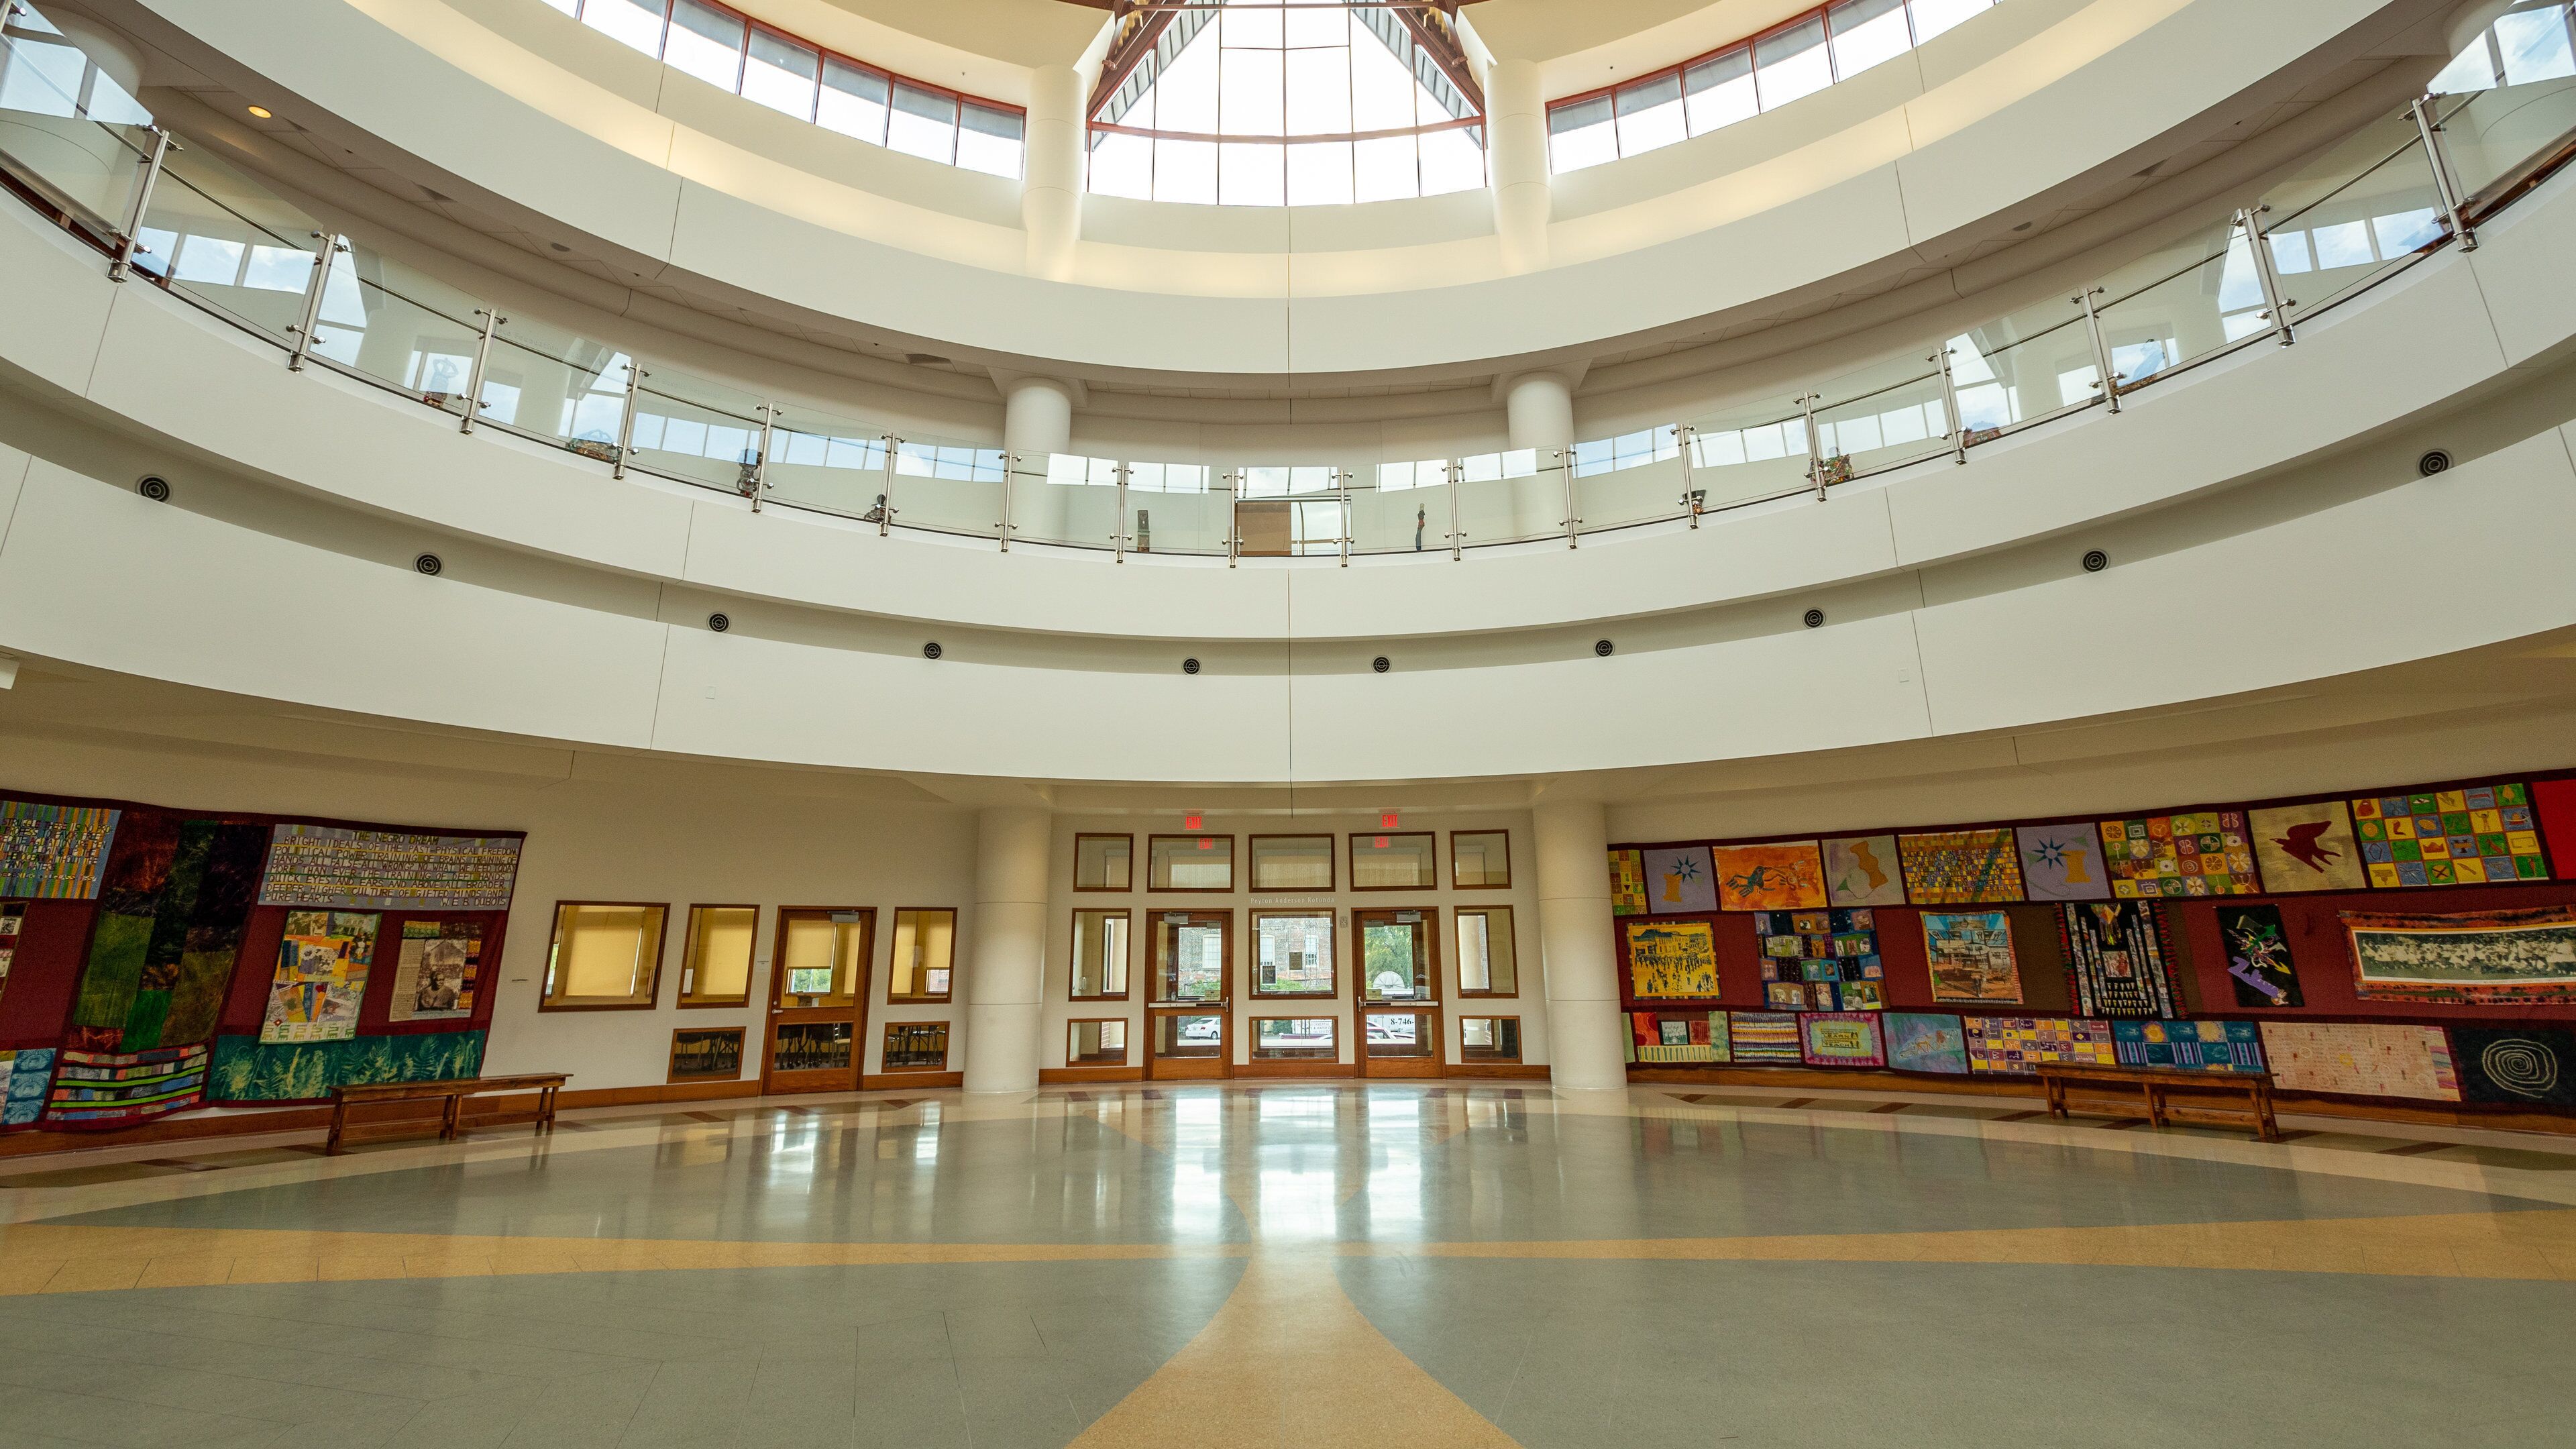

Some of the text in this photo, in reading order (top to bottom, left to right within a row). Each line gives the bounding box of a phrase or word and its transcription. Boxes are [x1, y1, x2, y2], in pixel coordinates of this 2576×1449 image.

[1186, 816, 1202, 829] EXIT
[1382, 814, 1397, 827] EXIT
[352, 831, 439, 845] THE NEGRO DREAM
[328, 839, 362, 850] IDEALS
[386, 843, 402, 852] THE
[274, 846, 331, 857] POLITICAL
[373, 852, 418, 862] TRAINING
[439, 856, 466, 864] BRAINS
[272, 855, 304, 865] HANDS
[309, 857, 325, 865] ALL
[382, 863, 414, 871] WRONG?
[270, 865, 297, 873] MORE
[303, 865, 327, 875] THAN
[384, 871, 431, 880] TRAINING
[306, 875, 331, 884] EYES
[337, 877, 355, 885] AND
[360, 879, 384, 888] EARS
[445, 881, 462, 889] ALL
[266, 883, 304, 892] DEEPER
[310, 885, 347, 894] HIGHER
[352, 887, 394, 896] CULTURE
[264, 893, 290, 902] PURE
[474, 898, 506, 906] DUBOIS
